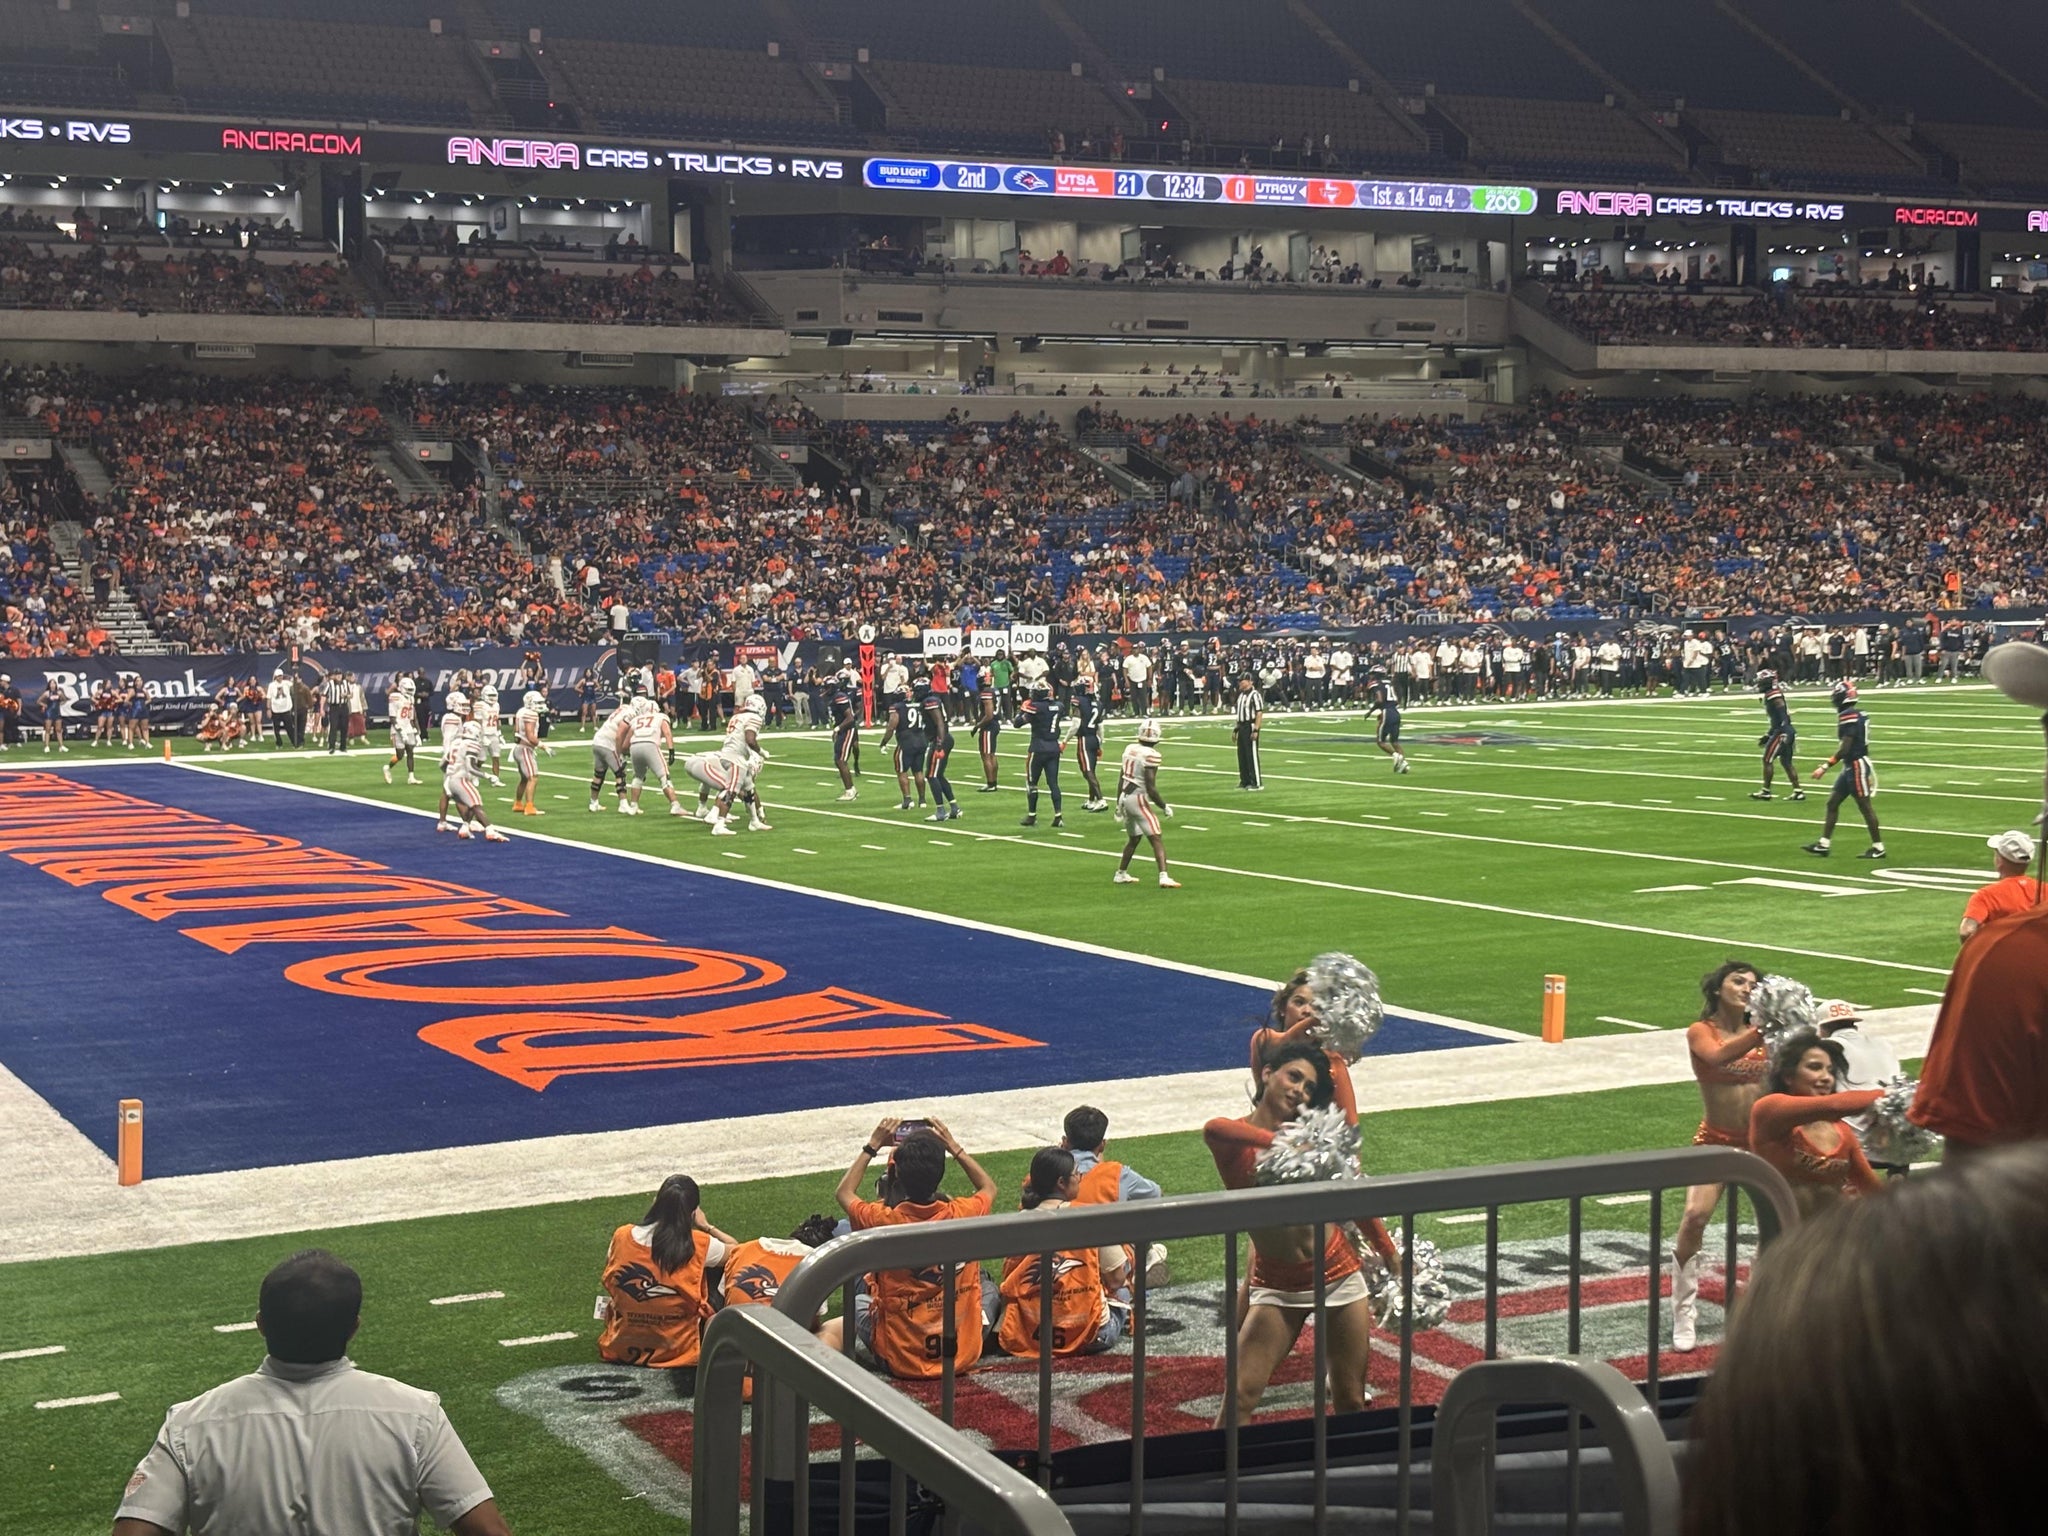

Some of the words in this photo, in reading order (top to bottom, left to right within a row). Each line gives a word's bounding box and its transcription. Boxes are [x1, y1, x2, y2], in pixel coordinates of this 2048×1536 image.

[0, 119, 43, 140] KS
[67, 122, 131, 143] RVS
[222, 129, 361, 155] ANCIRA.COM
[447, 137, 580, 170] ANCIRA
[586, 148, 649, 169] CARS
[667, 152, 773, 176] TRUCKS
[791, 158, 843, 180] RVS
[879, 166, 901, 176] BUD
[901, 167, 928, 177] LIGHT
[957, 166, 986, 188] 2nd
[1058, 173, 1096, 186] UTSA
[1117, 174, 1136, 195] 21
[1163, 176, 1205, 199] 12:34
[1235, 180, 1246, 199] 0
[1255, 182, 1298, 195] UTRGV
[1371, 186, 1392, 206] 1st
[1394, 190, 1405, 206] &
[1409, 187, 1425, 206] 14
[1428, 194, 1443, 207] on
[1444, 188, 1456, 208] 4
[1485, 194, 1521, 212] ZOO
[1557, 190, 1652, 217] ANCIRA
[1656, 197, 1703, 215] CARS
[1715, 199, 1793, 218] TRUCKS
[1805, 203, 1844, 221] RVS
[1895, 207, 1978, 226] ANCIRA.COM
[927, 635, 958, 647] ADO
[975, 637, 1005, 649] ADO
[1014, 632, 1045, 645] ADO
[434, 668, 580, 692] FOOTBLL
[636, 716, 655, 730] 57
[1087, 707, 1099, 729] 2
[1032, 1324, 1066, 1349] 6
